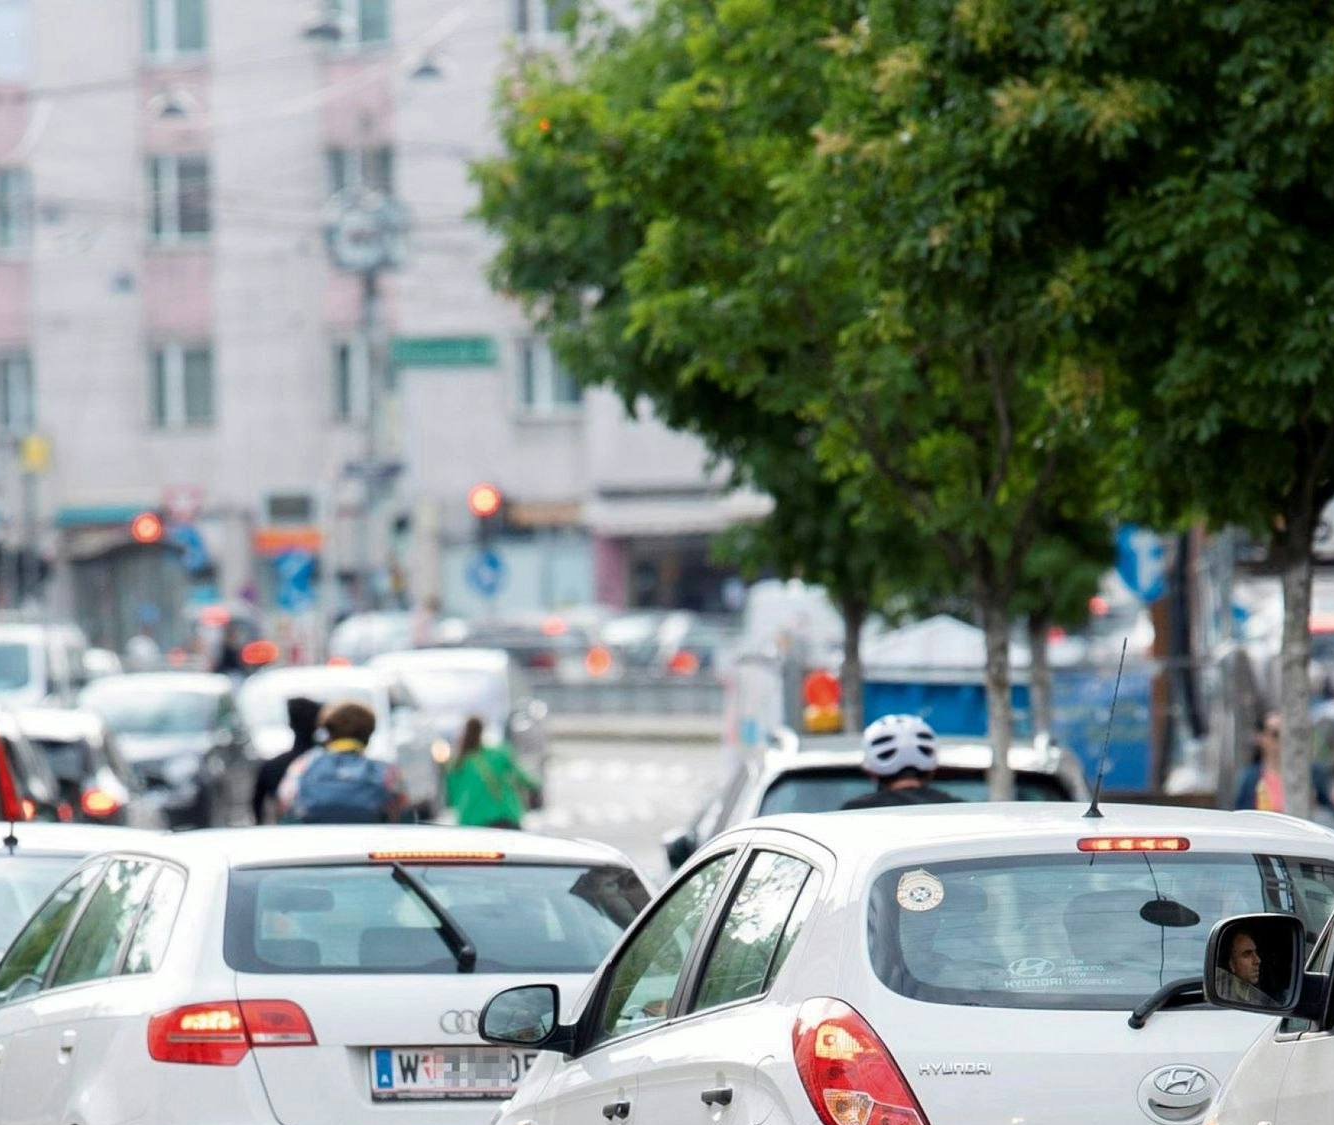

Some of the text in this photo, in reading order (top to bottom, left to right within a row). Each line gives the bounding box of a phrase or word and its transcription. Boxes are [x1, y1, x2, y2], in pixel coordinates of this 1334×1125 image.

[1004, 977, 1063, 988] HYUNDAI
[398, 1053, 419, 1084] W
[919, 1061, 992, 1076] HYUNDAI
